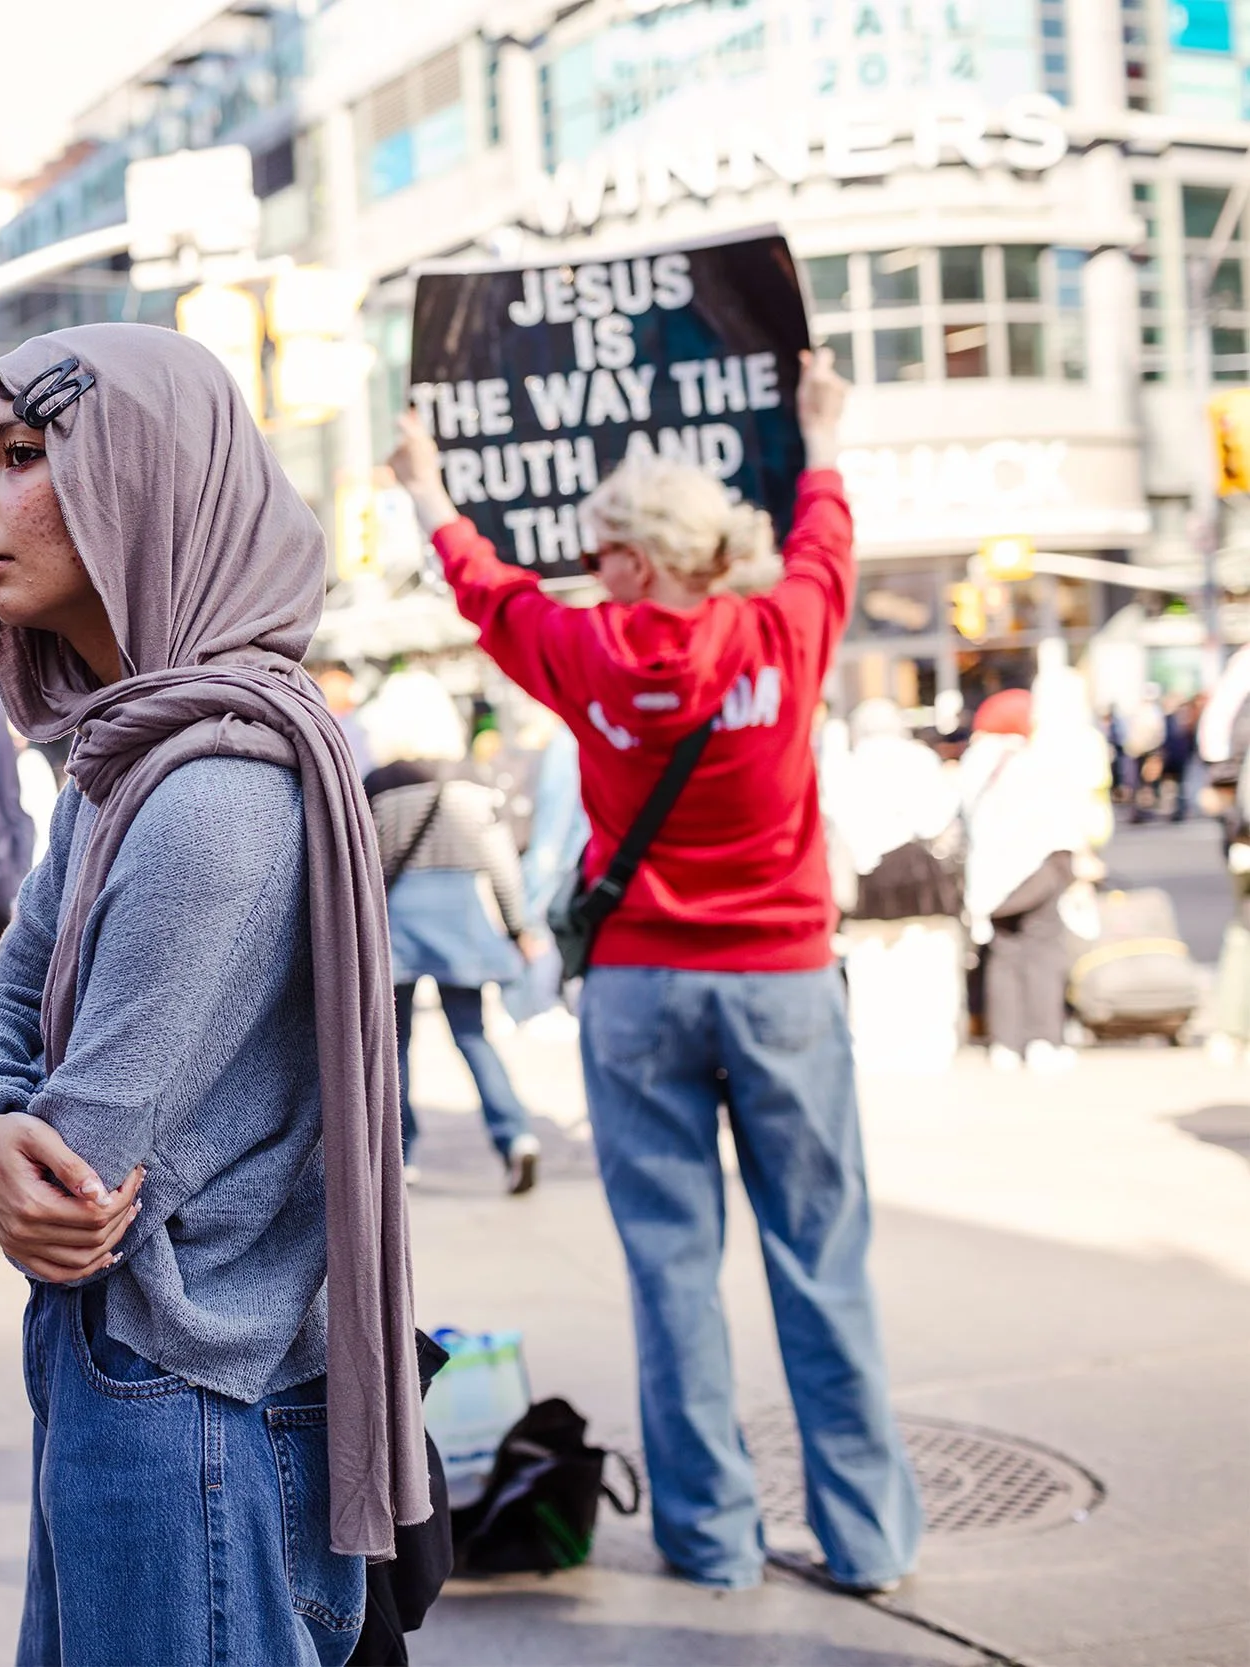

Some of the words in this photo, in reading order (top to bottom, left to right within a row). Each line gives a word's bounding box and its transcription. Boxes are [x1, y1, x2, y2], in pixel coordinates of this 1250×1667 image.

[528, 93, 1069, 234] WINNERS
[508, 252, 695, 328] JESUS
[572, 313, 637, 372] IS
[410, 377, 514, 440] THE
[524, 363, 657, 431] WAY
[669, 351, 782, 418] THE
[437, 435, 600, 506] RUTH
